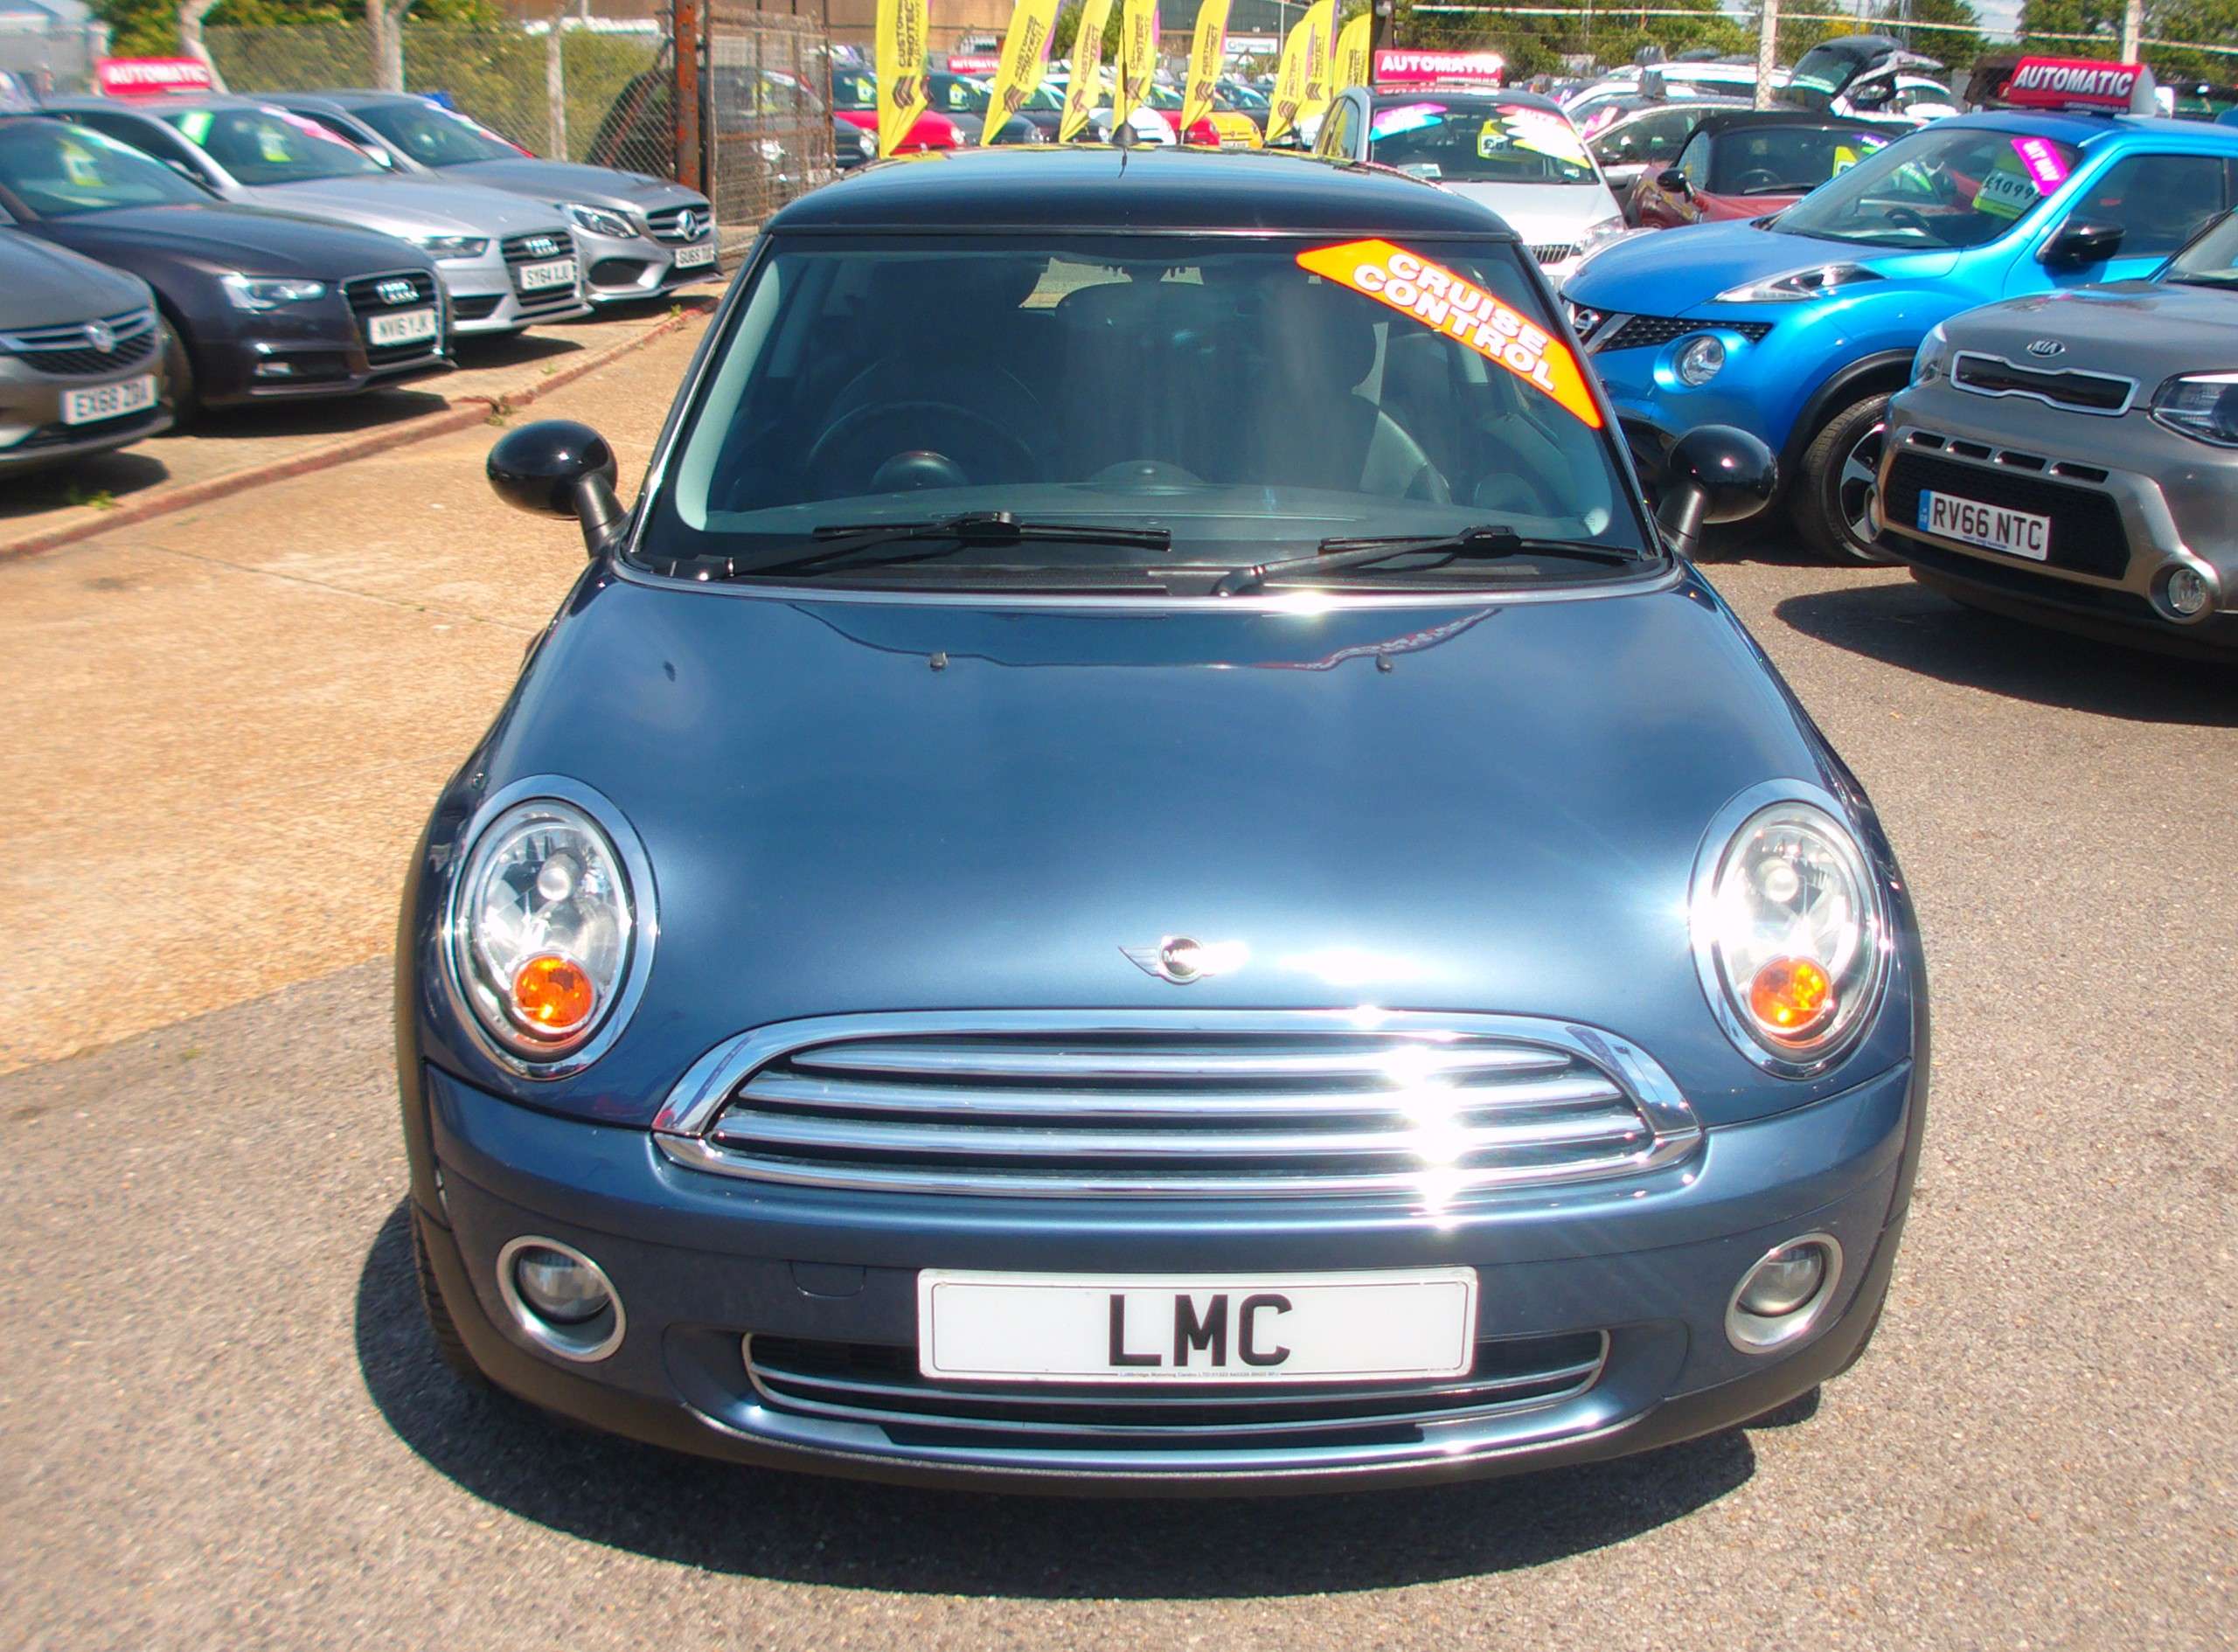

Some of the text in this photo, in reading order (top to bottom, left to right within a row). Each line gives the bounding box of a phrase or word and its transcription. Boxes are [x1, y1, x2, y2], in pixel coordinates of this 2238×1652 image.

[906, 0, 915, 67] PROTEC
[111, 64, 209, 85] AUTOMATIC
[1381, 55, 1500, 74] AUTOMATIC
[2012, 65, 2133, 98] AUTOMATIC
[1984, 176, 2036, 201] £1099
[1388, 253, 1549, 357] CRUISE
[1352, 264, 1554, 392] CONTROL
[2032, 340, 2058, 354] KIA
[1933, 497, 2043, 551] RV66 NTC
[1109, 1293, 1293, 1367] LMC
